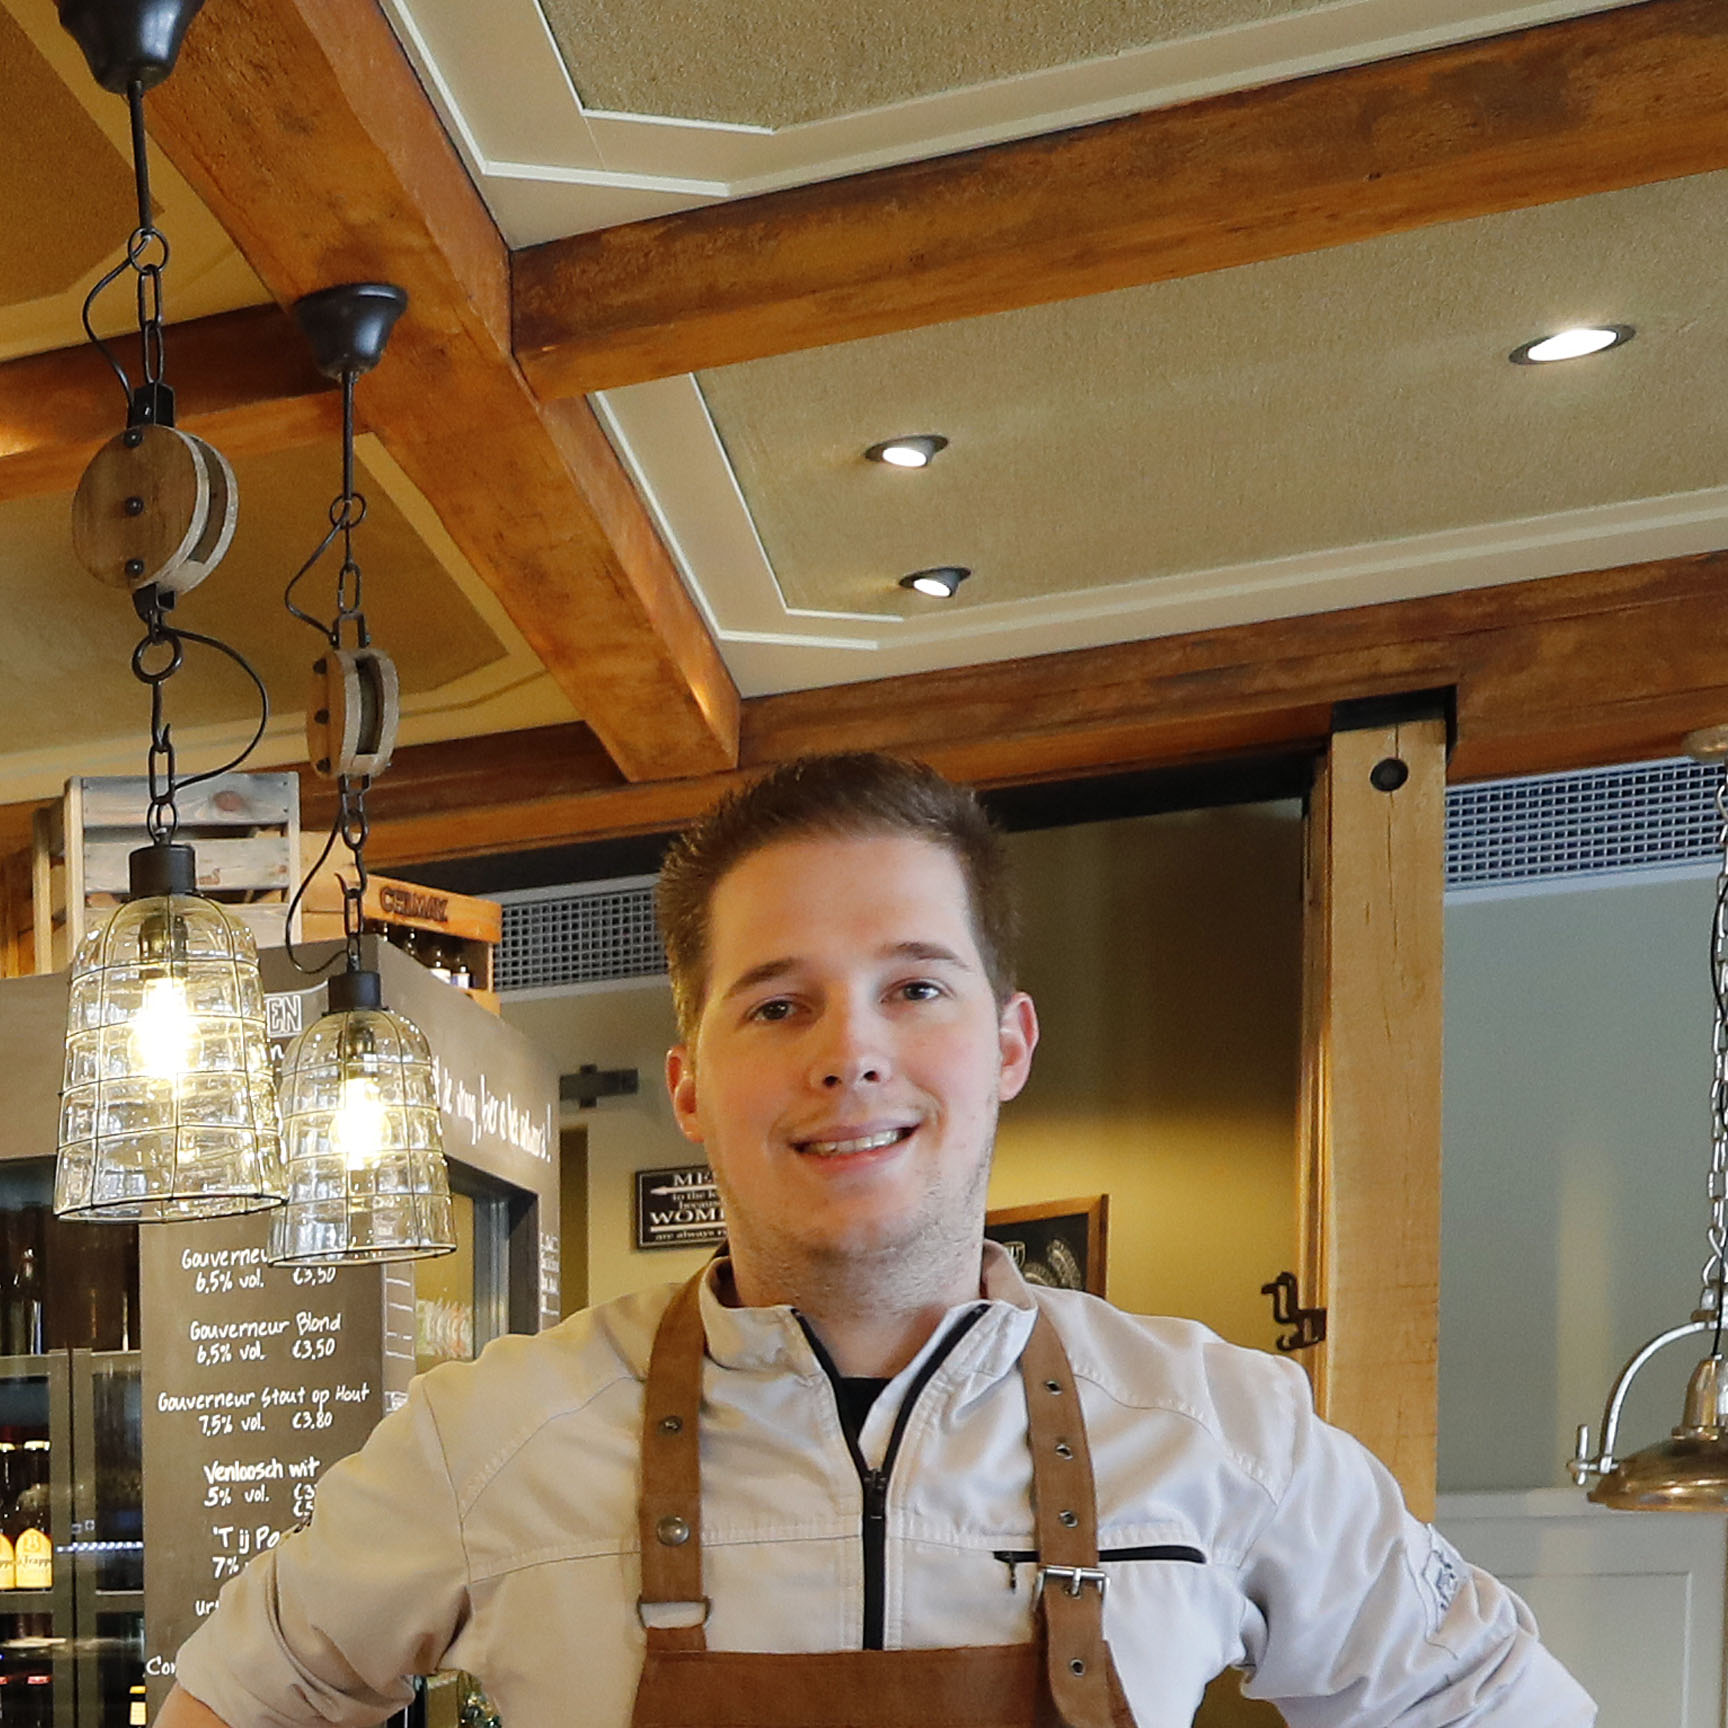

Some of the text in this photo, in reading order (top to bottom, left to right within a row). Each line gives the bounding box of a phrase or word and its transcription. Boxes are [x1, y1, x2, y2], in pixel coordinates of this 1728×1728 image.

[239, 1267, 265, 1289] vol.
[190, 1311, 342, 1341] Gouverneur Blond
[239, 1340, 266, 1361] vol.
[157, 1390, 256, 1412] Gouverneur
[261, 1385, 306, 1409] Stout
[311, 1389, 331, 1412] op
[335, 1382, 370, 1402] Hout
[241, 1411, 266, 1432] vol.
[203, 1455, 321, 1485] Venloosch wit
[203, 1485, 232, 1507] 5%
[244, 1483, 270, 1503] vol.
[255, 1525, 281, 1550] Po
[212, 1556, 240, 1579] 7%
